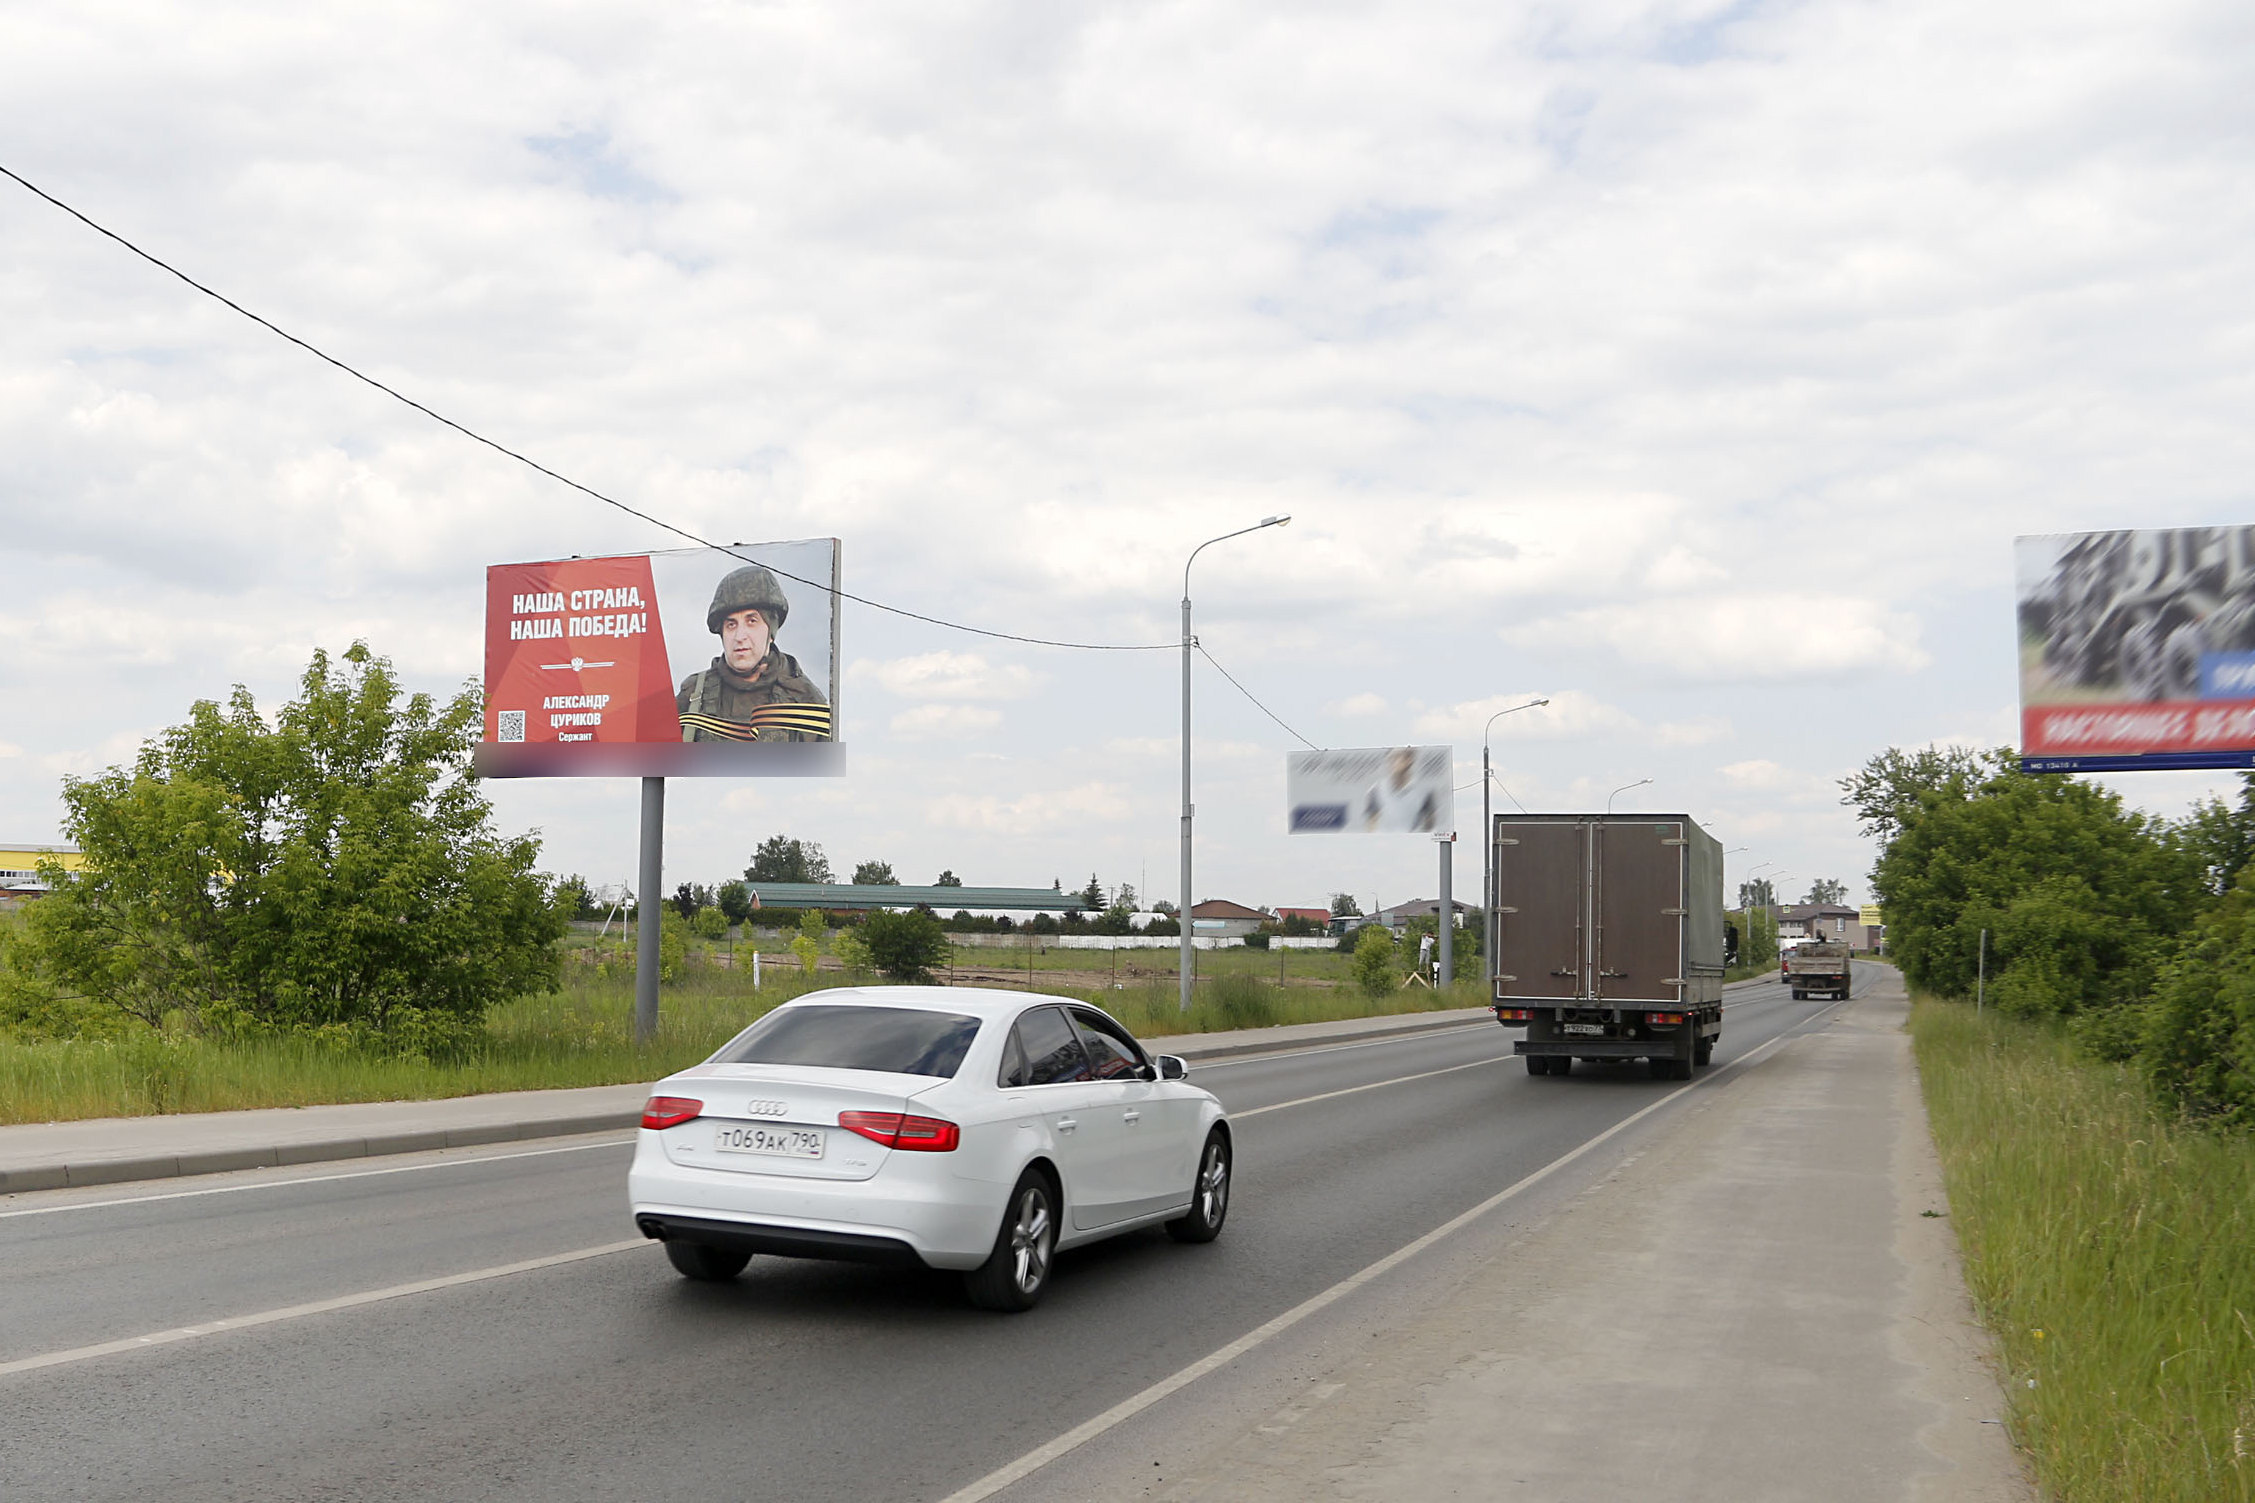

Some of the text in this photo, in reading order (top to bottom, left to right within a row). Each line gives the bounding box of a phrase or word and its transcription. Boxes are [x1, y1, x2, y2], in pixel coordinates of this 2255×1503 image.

[513, 586, 646, 614] НАША СТРАНА,
[510, 612, 647, 640] НАША ПОБЕДА!
[543, 694, 610, 710] АЛЕКСАНДР
[550, 712, 602, 729] ЦУРИКОВ
[558, 731, 593, 742] Сержант
[722, 1129, 818, 1151] Т069АК 790
